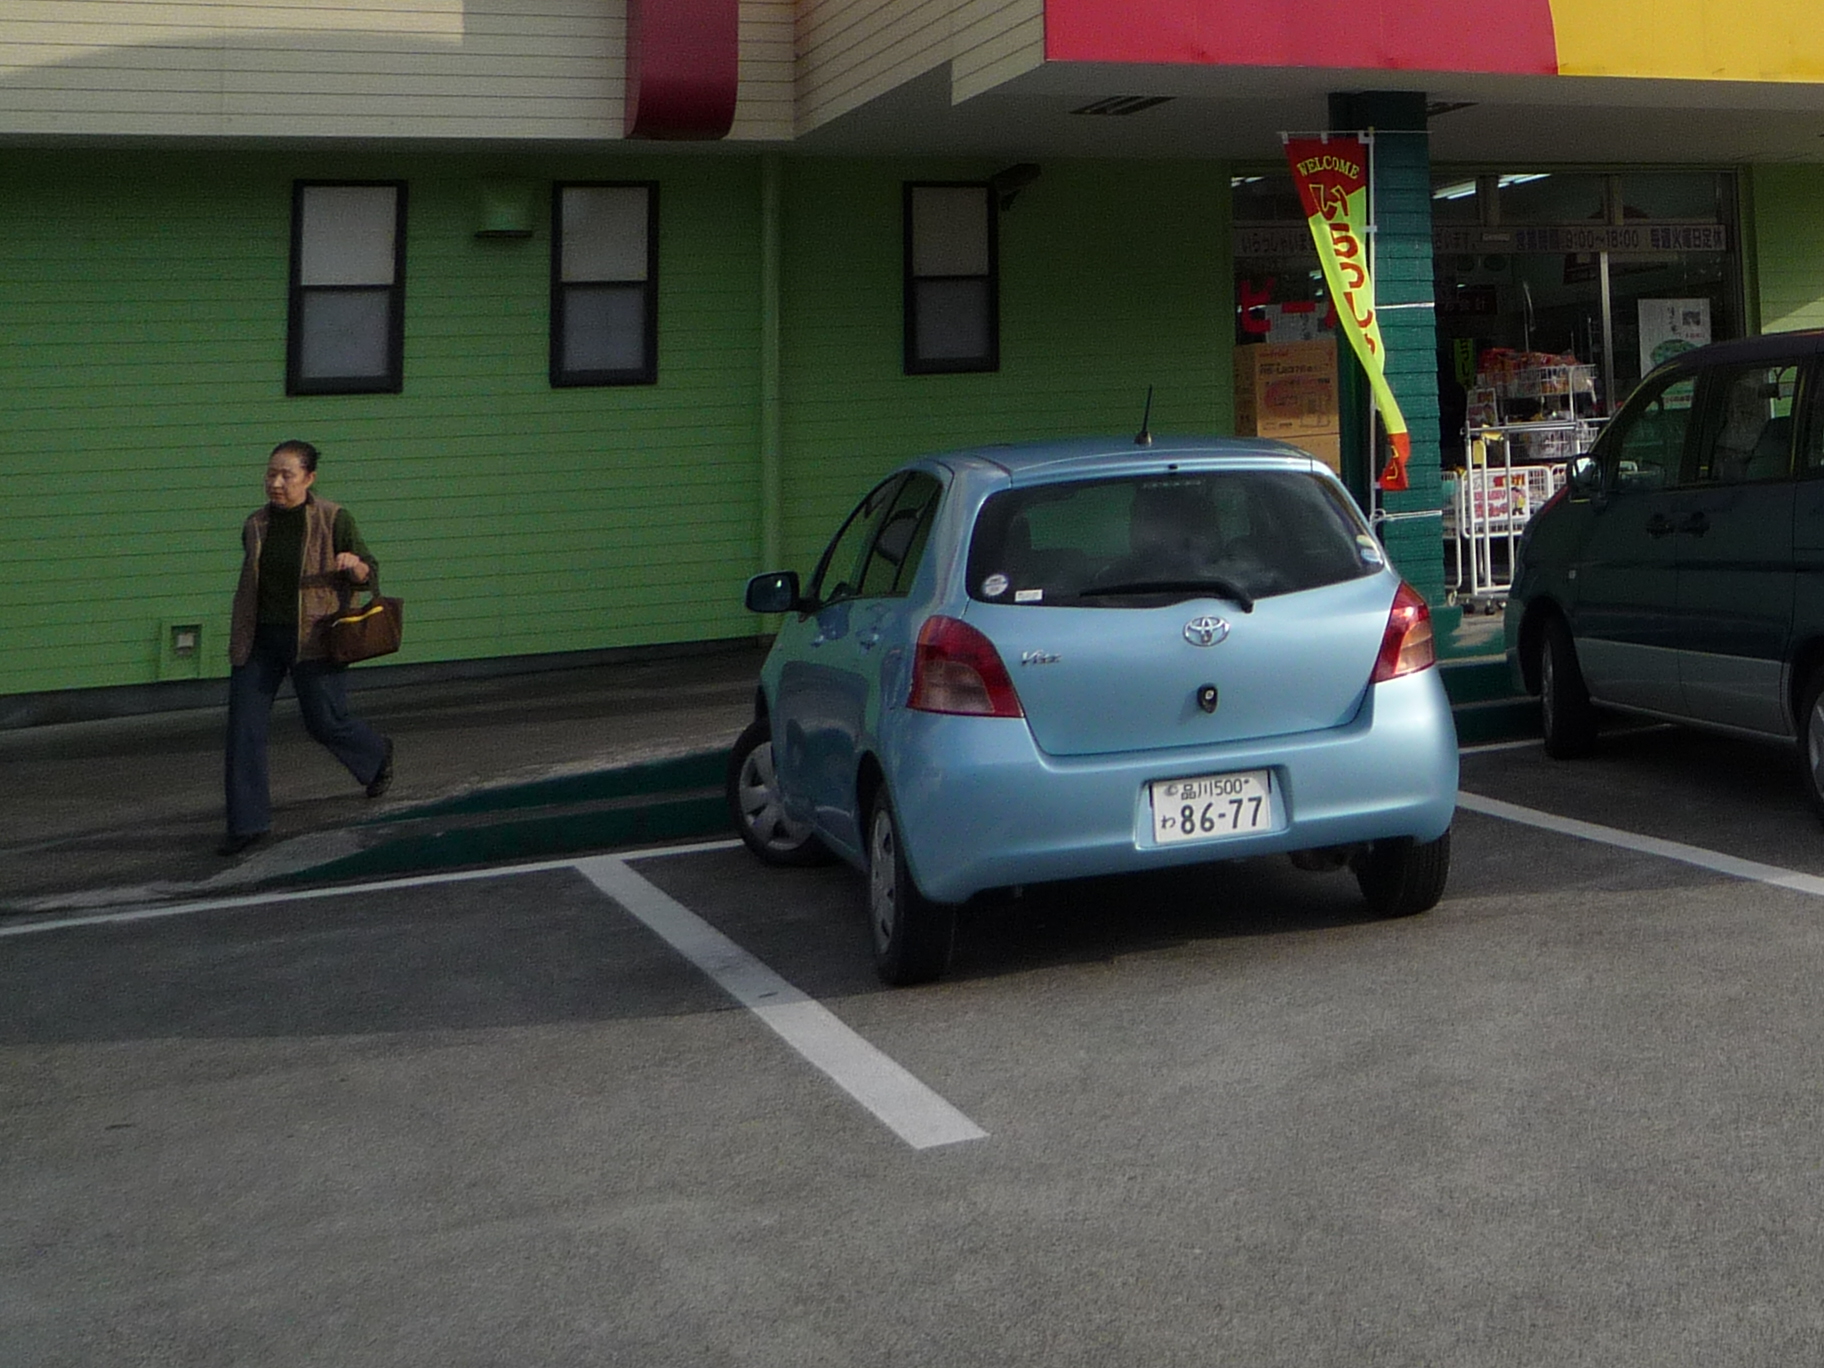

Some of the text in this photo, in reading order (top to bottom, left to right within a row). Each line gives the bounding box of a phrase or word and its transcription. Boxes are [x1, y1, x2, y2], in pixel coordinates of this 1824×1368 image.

[1297, 154, 1361, 180] WELCOME
[1181, 778, 1243, 801] 品川500
[1180, 796, 1263, 835] 86-77
